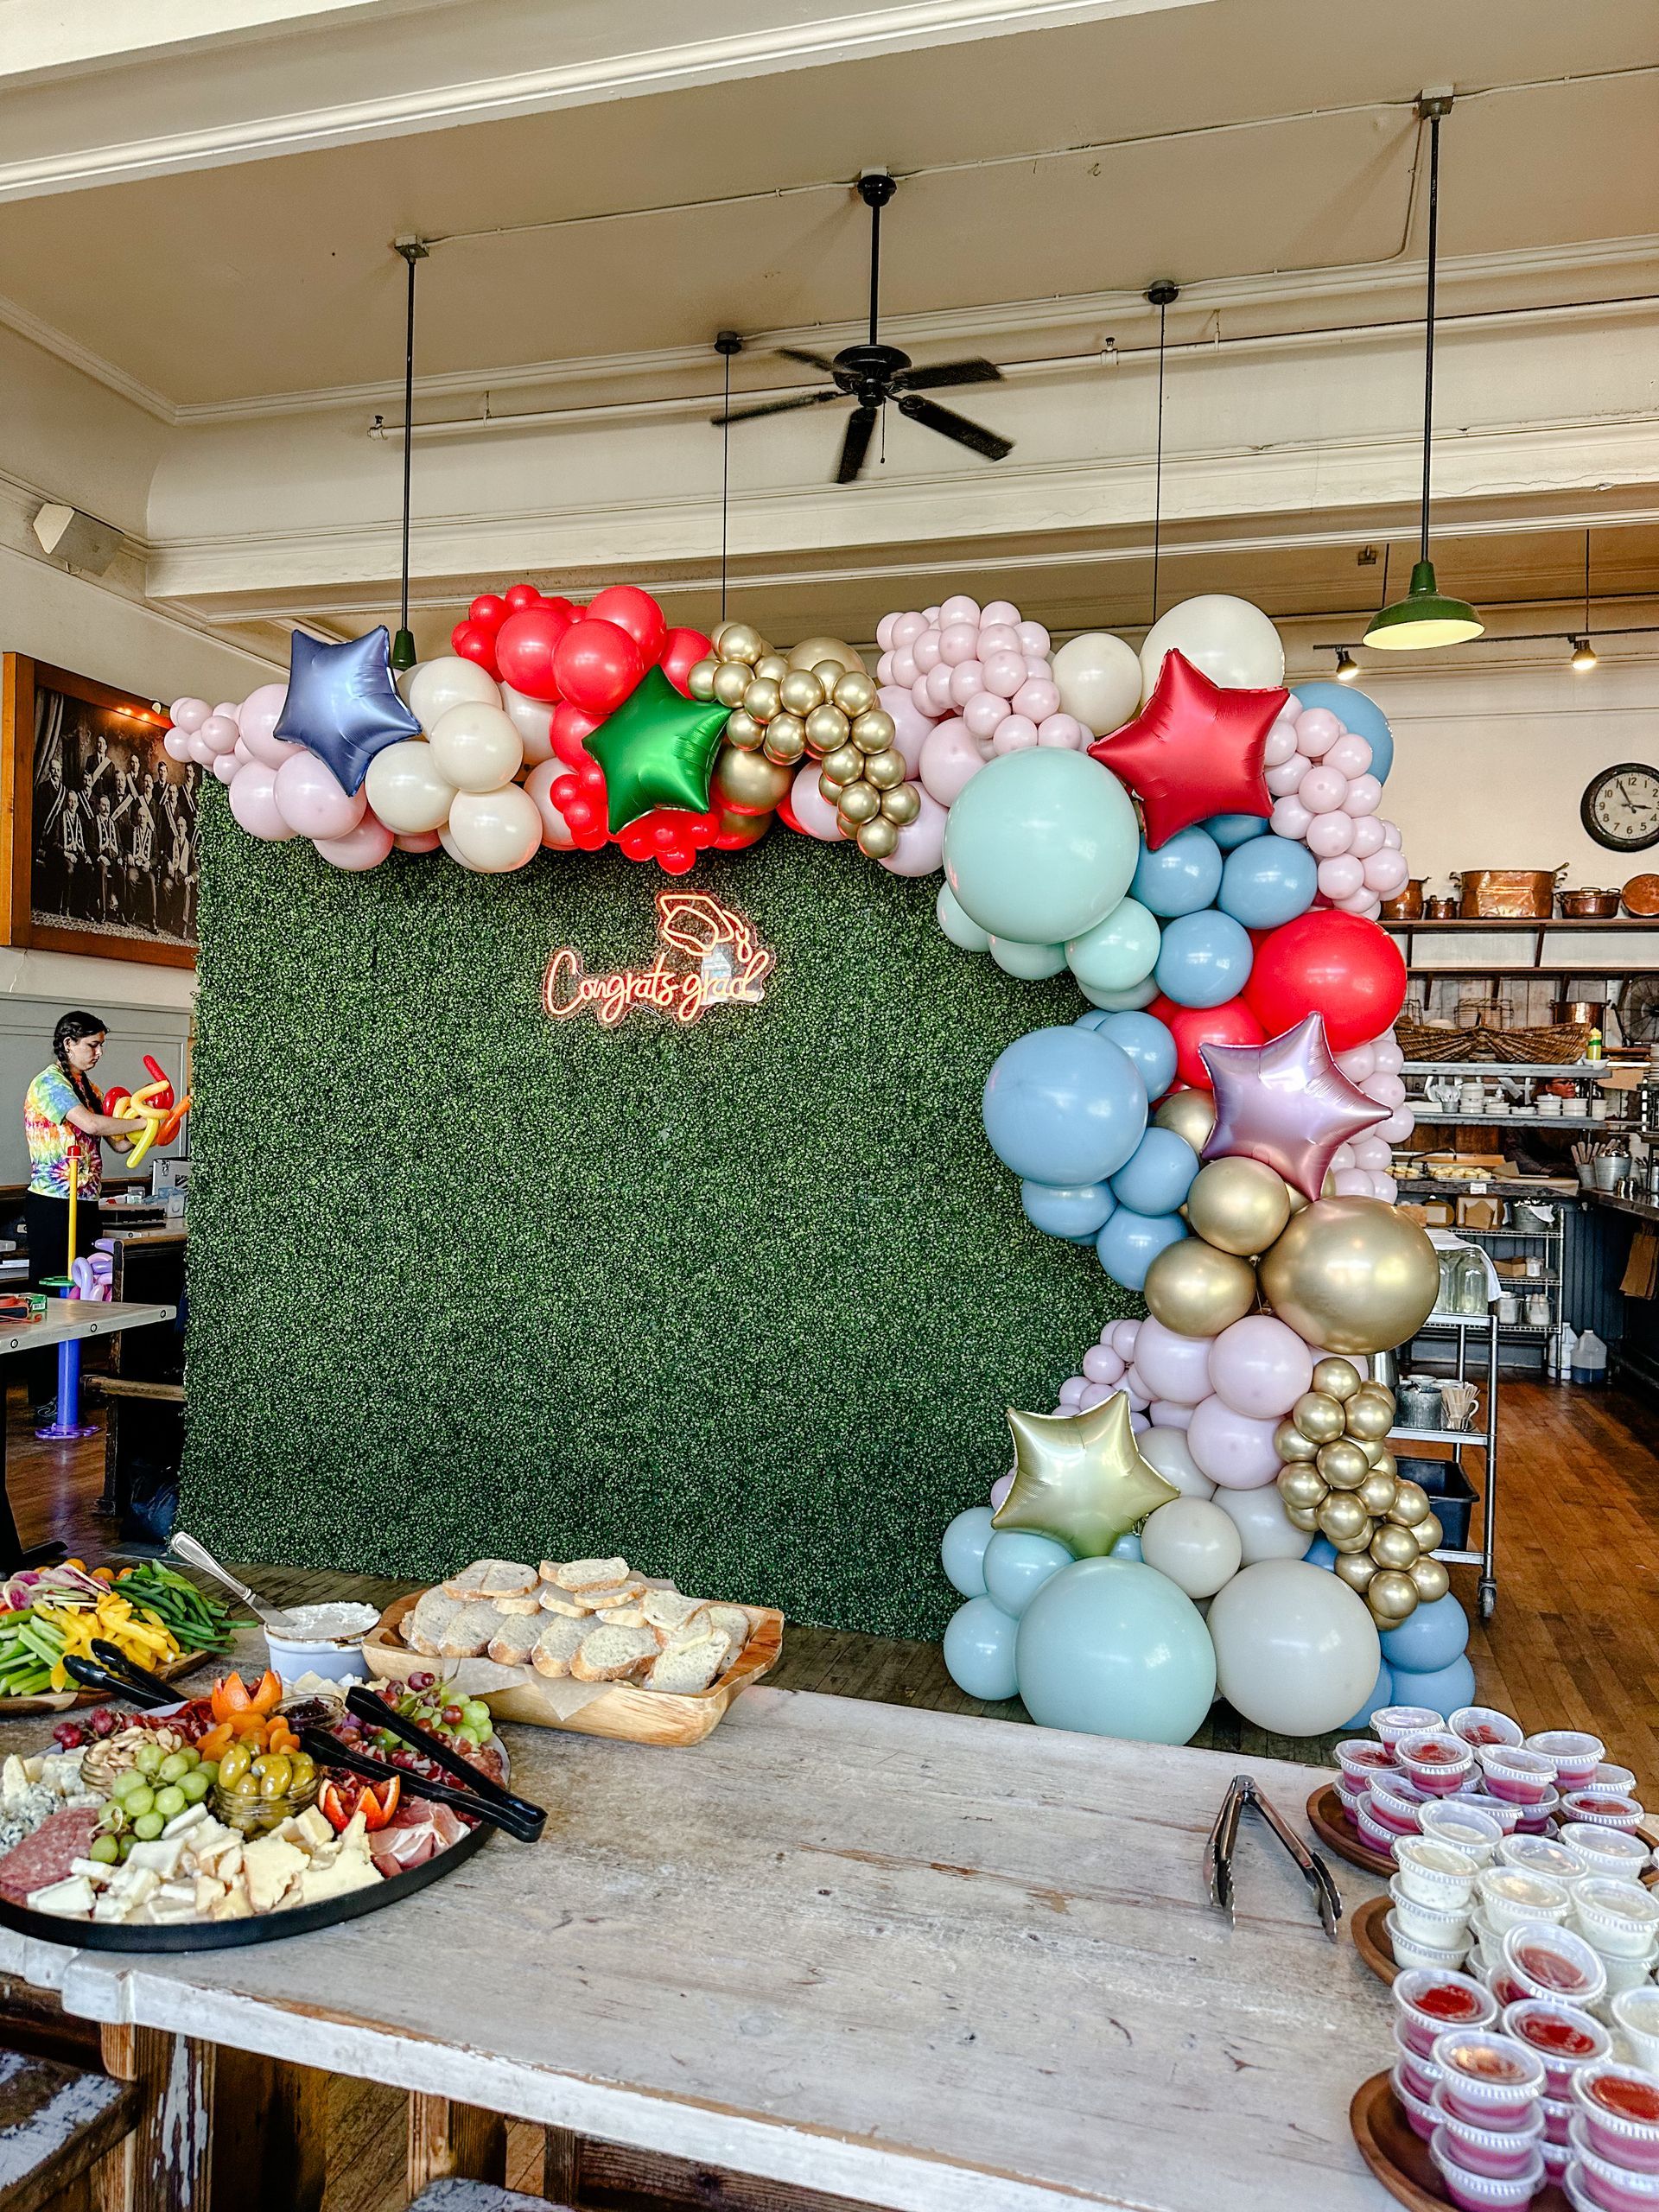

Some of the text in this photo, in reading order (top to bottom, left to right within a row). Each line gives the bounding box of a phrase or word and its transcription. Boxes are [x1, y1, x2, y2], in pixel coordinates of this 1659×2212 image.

[1628, 777, 1637, 786] 12
[1605, 789, 1613, 798] 10
[1652, 788, 1659, 798] 2
[1599, 801, 1605, 810] 9
[1603, 813, 1610, 823] 8
[1649, 813, 1657, 822] 4
[1613, 822, 1620, 831] 7
[1626, 825, 1633, 835] 6
[1640, 822, 1647, 831] 5
[547, 950, 770, 1023] Congrats grad
